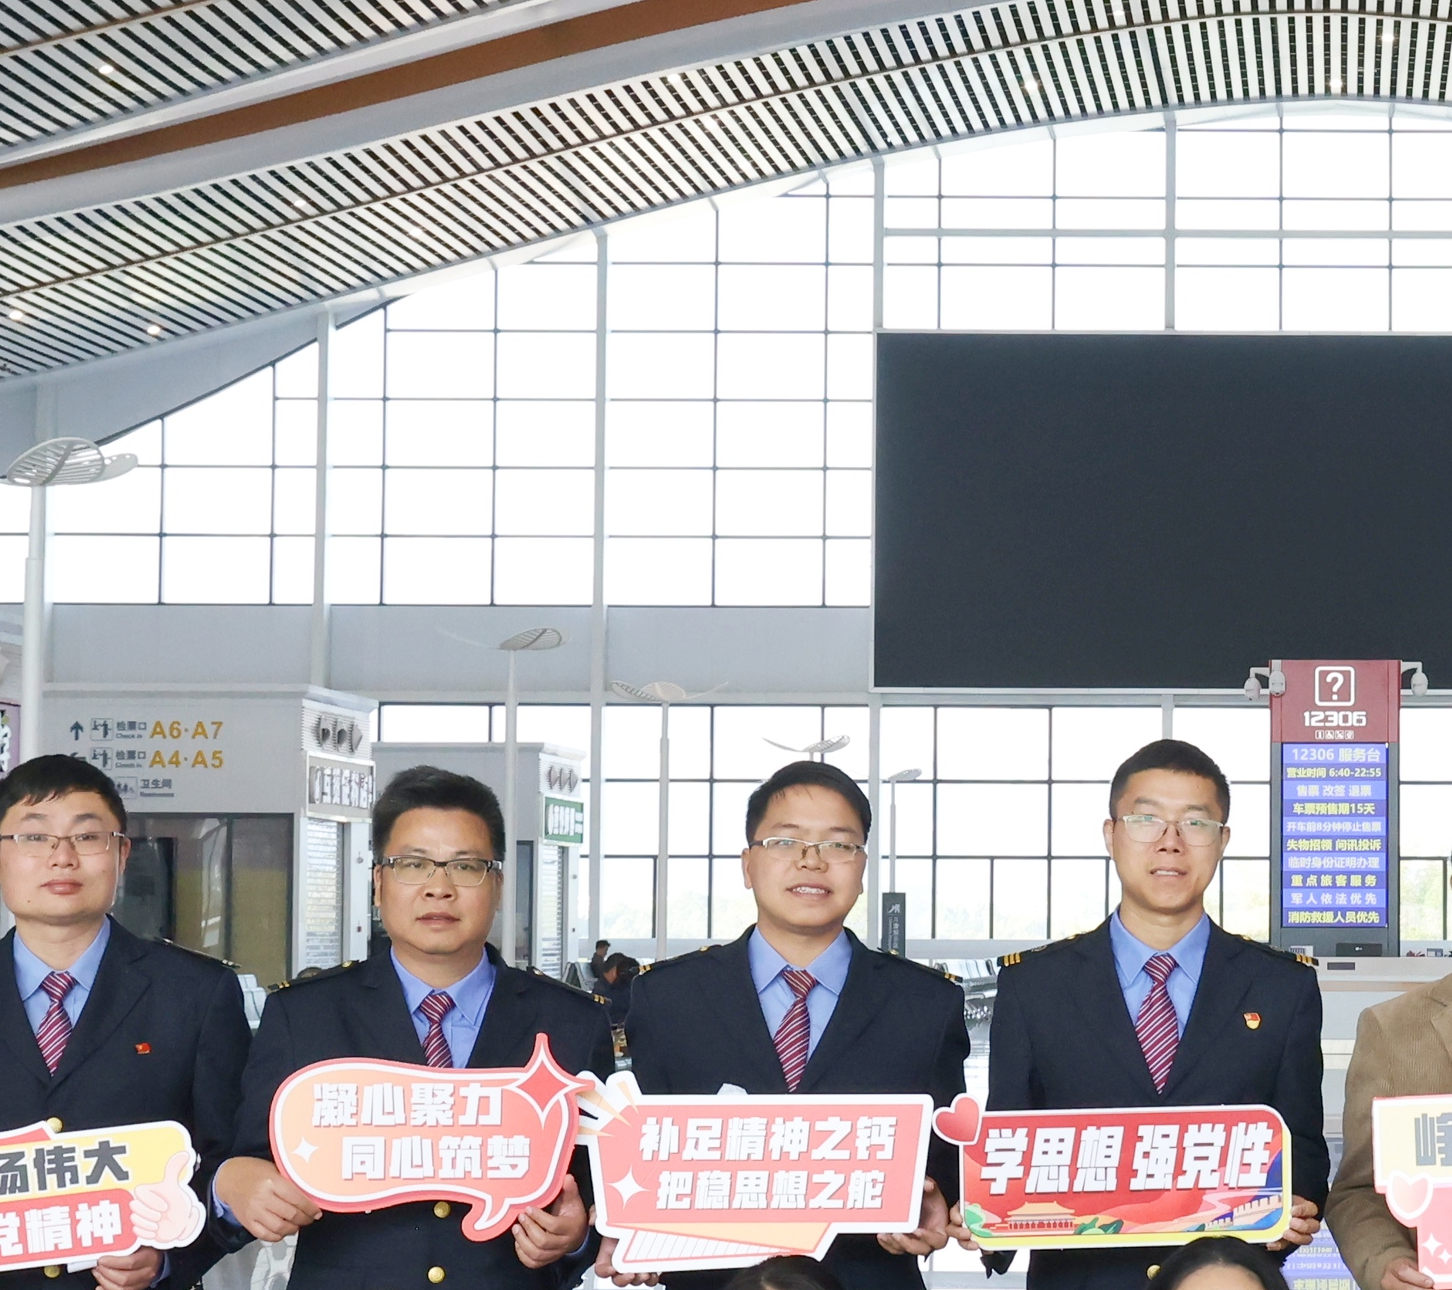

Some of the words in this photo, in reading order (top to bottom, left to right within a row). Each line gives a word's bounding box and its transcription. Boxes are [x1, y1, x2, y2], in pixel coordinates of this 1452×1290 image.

[1303, 711, 1367, 727] 12306
[1292, 748, 1335, 761] 12306
[1338, 747, 1381, 762] 服务台
[1286, 767, 1327, 778] 营业时间
[1329, 767, 1381, 777] 6:40-22:55
[1297, 785, 1319, 797] 售票
[1322, 785, 1345, 797] 改签
[1292, 802, 1375, 815] 车票预售期15天
[1286, 838, 1333, 851] 失物招领
[1335, 838, 1382, 851] 问讯投诉
[1288, 856, 1380, 869] 临时身份证明办理
[1290, 874, 1377, 887] 重点旅客服务
[1290, 892, 1377, 905] 军人依法优先
[1288, 911, 1380, 923] 消防救援人员优先
[312, 1082, 503, 1128] 凝心聚力
[639, 1115, 898, 1161] 补足精神之钙
[341, 1134, 531, 1181] 同心筑梦
[980, 1125, 1125, 1195] 学思想
[1129, 1121, 1273, 1191] 强党性
[655, 1170, 886, 1211] 把稳思想之舵
